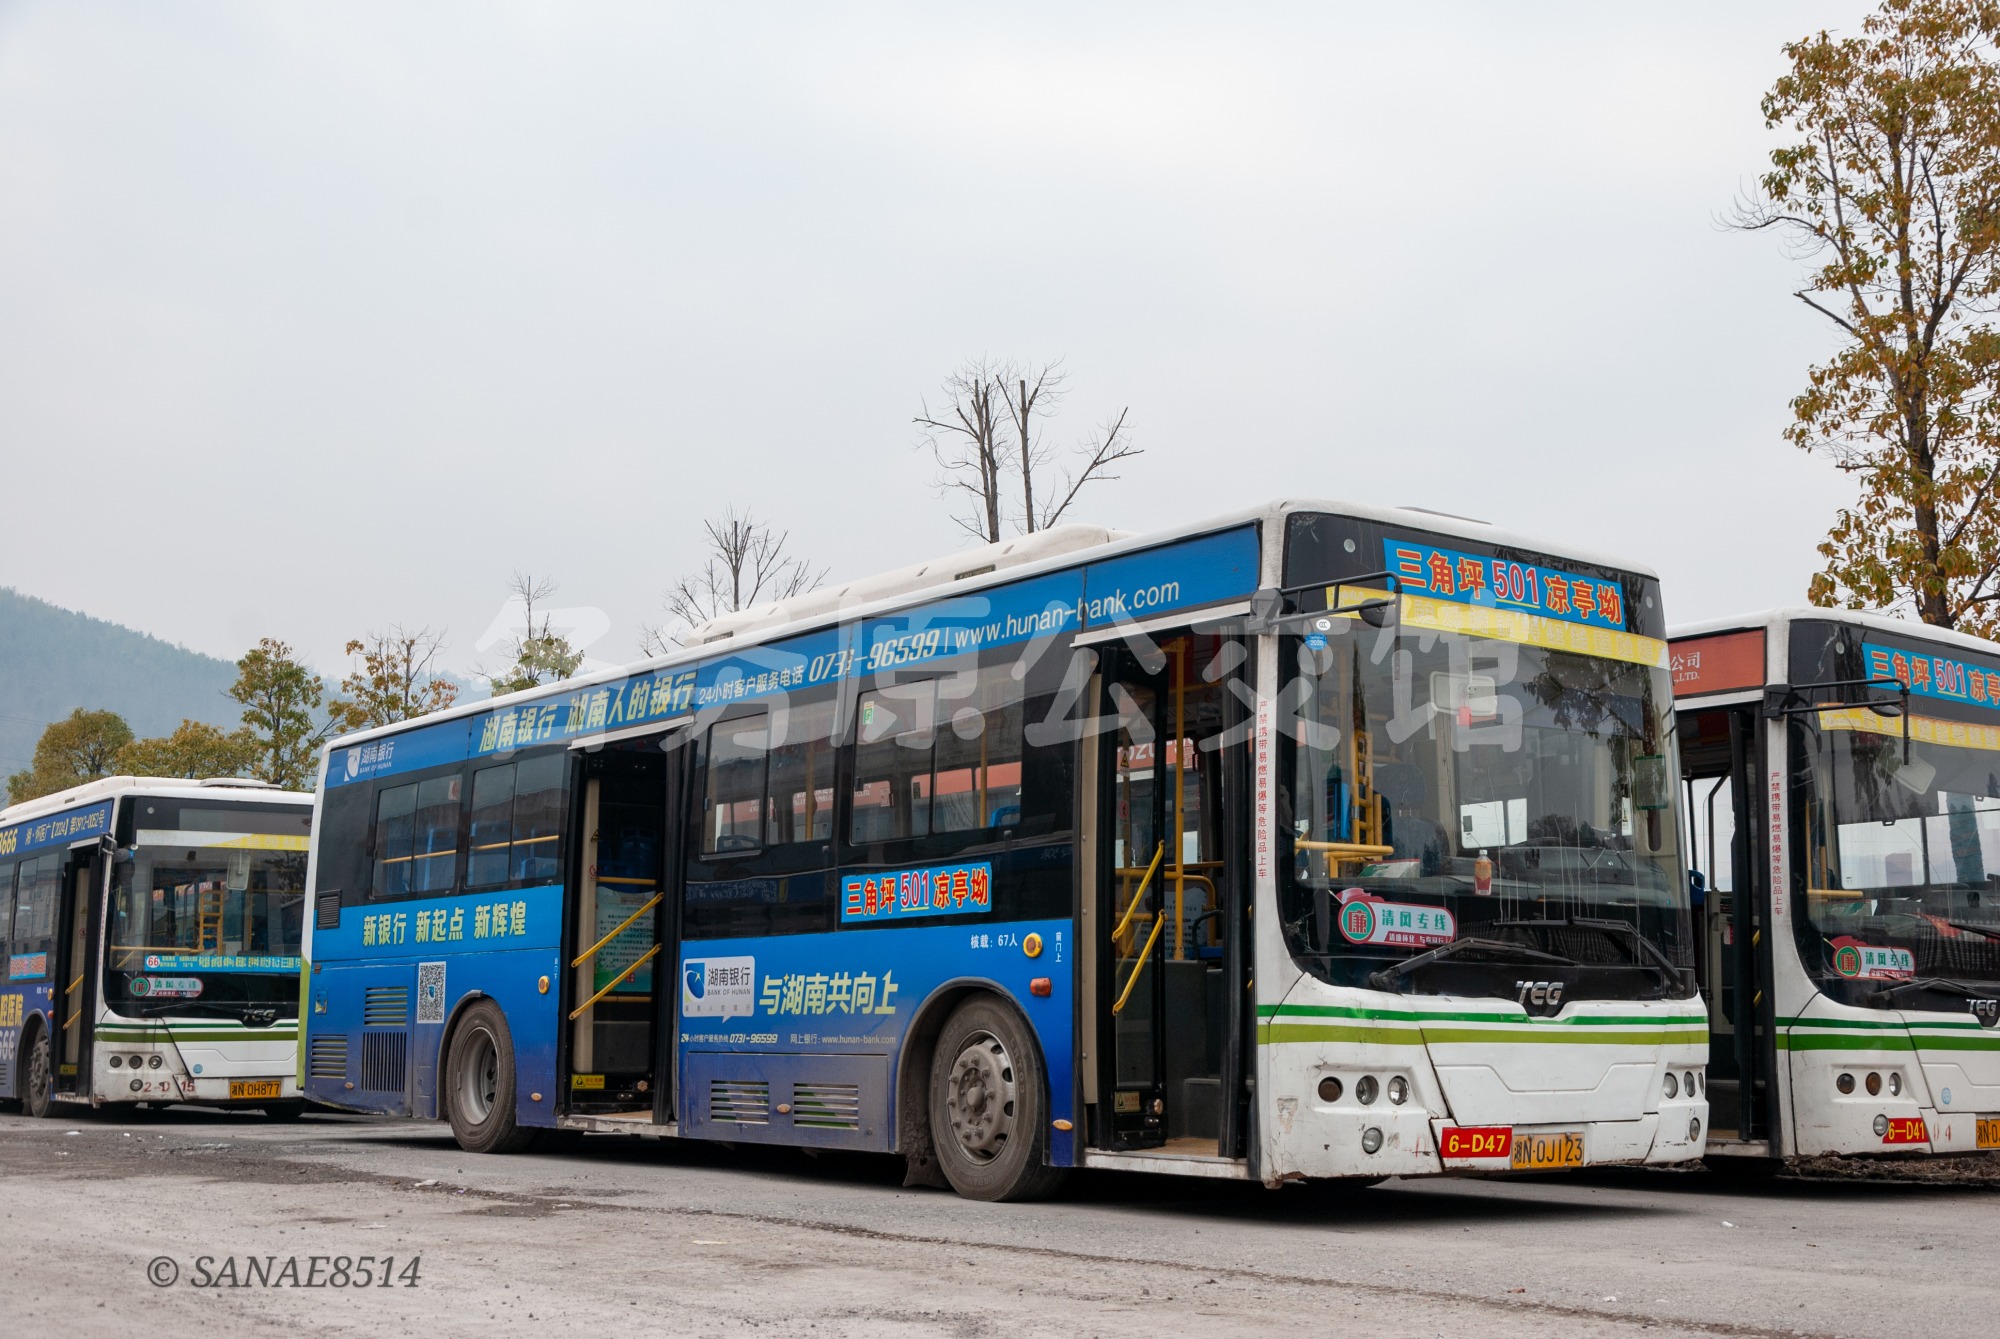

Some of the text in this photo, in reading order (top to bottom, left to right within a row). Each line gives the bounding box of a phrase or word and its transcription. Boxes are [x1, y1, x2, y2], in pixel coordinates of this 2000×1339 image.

[1395, 547, 1623, 625] 三角坪 501 凉亭坳
[698, 664, 804, 705] 24小时客户服务电话
[955, 580, 1180, 649] www.hunan-bank.com
[1933, 658, 1966, 695] 501
[478, 671, 698, 753] 湖南银行 湖南人的银行
[846, 866, 989, 917] 三角坪 501 凉亭坳
[362, 901, 527, 947] 新银行 新起点 新辉煌
[1382, 909, 1446, 931] 清风专线
[147, 956, 160, 967] 66
[707, 966, 751, 987] 湖南银行
[707, 988, 721, 996] BANK
[722, 988, 730, 996] OF
[758, 969, 899, 1017] 与湖南共向上
[1516, 980, 1564, 1006] TEG
[1966, 999, 1997, 1016] TEG
[729, 1033, 778, 1044] 0731-96599
[822, 1034, 896, 1045] www.hunan-bank.com
[1449, 1134, 1506, 1154] 6-D47
